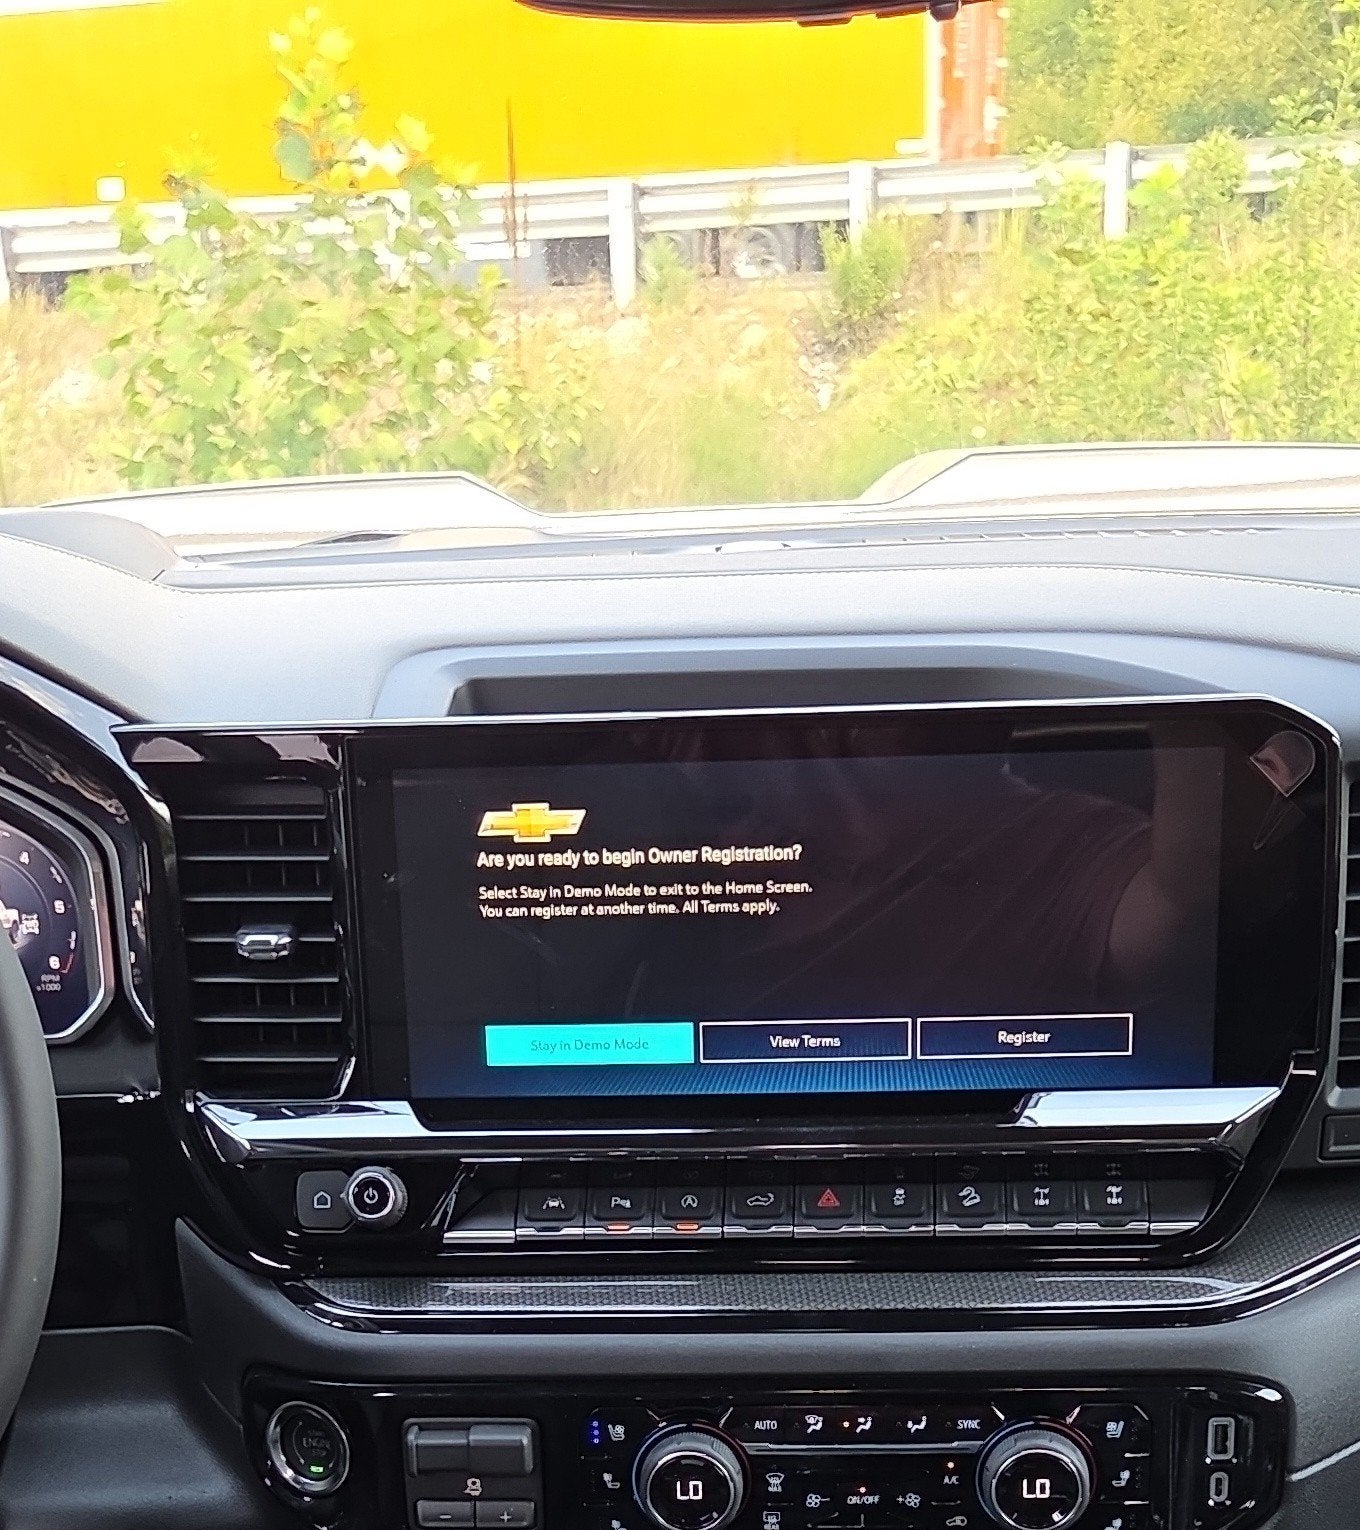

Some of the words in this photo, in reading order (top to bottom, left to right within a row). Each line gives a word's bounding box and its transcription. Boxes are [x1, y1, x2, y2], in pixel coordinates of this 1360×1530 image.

[19, 851, 30, 865] 4
[477, 851, 504, 868] Are
[507, 853, 535, 870] you
[538, 849, 580, 869] ready
[583, 850, 599, 866] to
[603, 848, 645, 868] begin
[648, 847, 698, 864] Owner
[701, 844, 803, 866] Registration?
[478, 885, 518, 900] Select
[520, 885, 547, 901] Stay
[549, 885, 561, 898] in
[564, 884, 602, 898] Demo
[605, 883, 640, 897] Mode
[644, 884, 657, 896] to
[659, 883, 683, 896] exit
[685, 883, 699, 895] to
[701, 881, 723, 895] the
[725, 881, 763, 895] Home
[766, 880, 813, 894] Screen.
[54, 899, 65, 914] 5
[479, 904, 503, 918] You
[505, 906, 528, 917] can
[530, 904, 578, 920] register
[581, 903, 595, 916] at
[596, 901, 645, 915] another
[648, 902, 680, 915] time.
[682, 900, 699, 914] All
[700, 900, 740, 914] Terms
[742, 898, 780, 915] apply.
[49, 955, 60, 970] 6
[531, 1040, 557, 1054] Stay
[560, 1040, 571, 1051] in
[574, 1039, 610, 1050] Demo
[614, 1037, 649, 1050] Mode
[770, 1035, 800, 1048] View
[801, 1034, 841, 1047] Terms
[998, 1031, 1051, 1047] Register
[754, 1419, 778, 1430] AUTO
[956, 1419, 981, 1430] SYNC
[943, 1475, 960, 1485] A/C
[676, 1480, 703, 1500] LO
[1022, 1478, 1051, 1499] LO
[847, 1495, 880, 1505] ON/OFF
